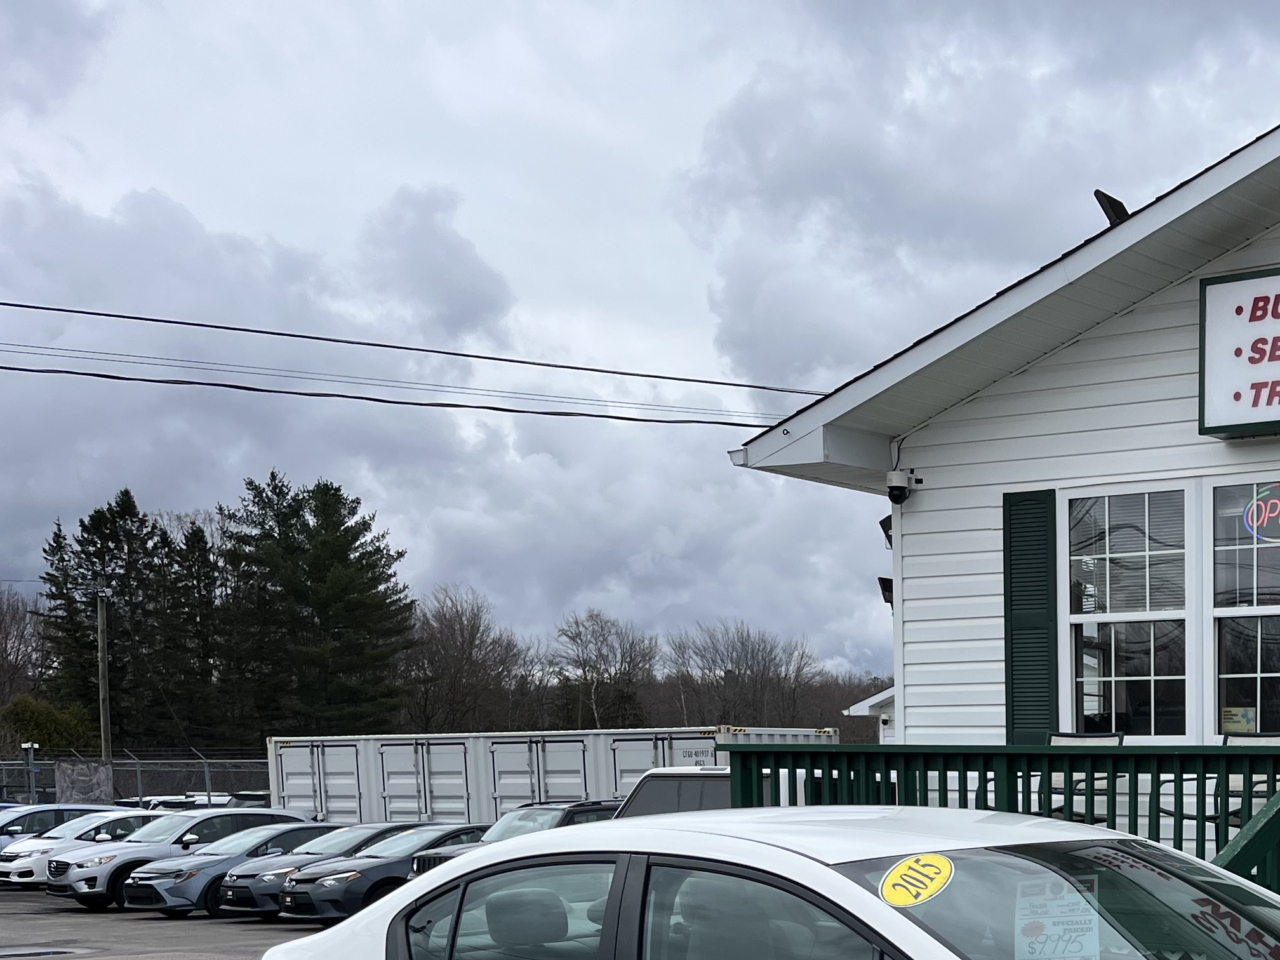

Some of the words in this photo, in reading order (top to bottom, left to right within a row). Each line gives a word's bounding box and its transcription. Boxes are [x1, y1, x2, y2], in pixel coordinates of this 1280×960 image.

[892, 858, 942, 900] 2015
[1052, 919, 1094, 927] SPECIALLY
[1063, 926, 1094, 934] PRICED!
